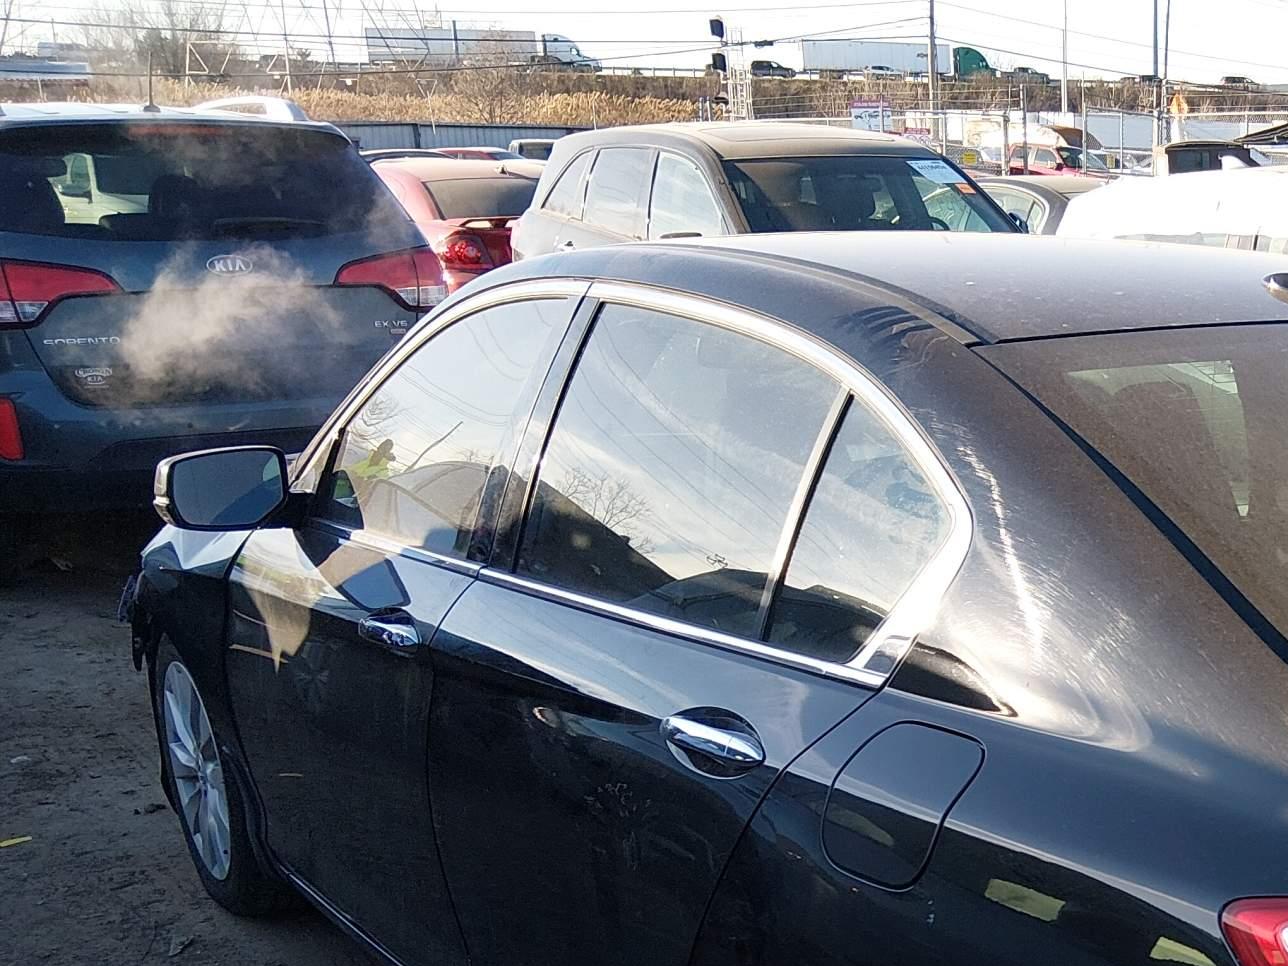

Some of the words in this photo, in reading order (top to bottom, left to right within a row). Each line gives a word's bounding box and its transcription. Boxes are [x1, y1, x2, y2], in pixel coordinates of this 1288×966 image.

[212, 259, 246, 272] KIA
[374, 320, 389, 328] EX
[392, 319, 408, 327] V6
[43, 336, 121, 345] SORENTO
